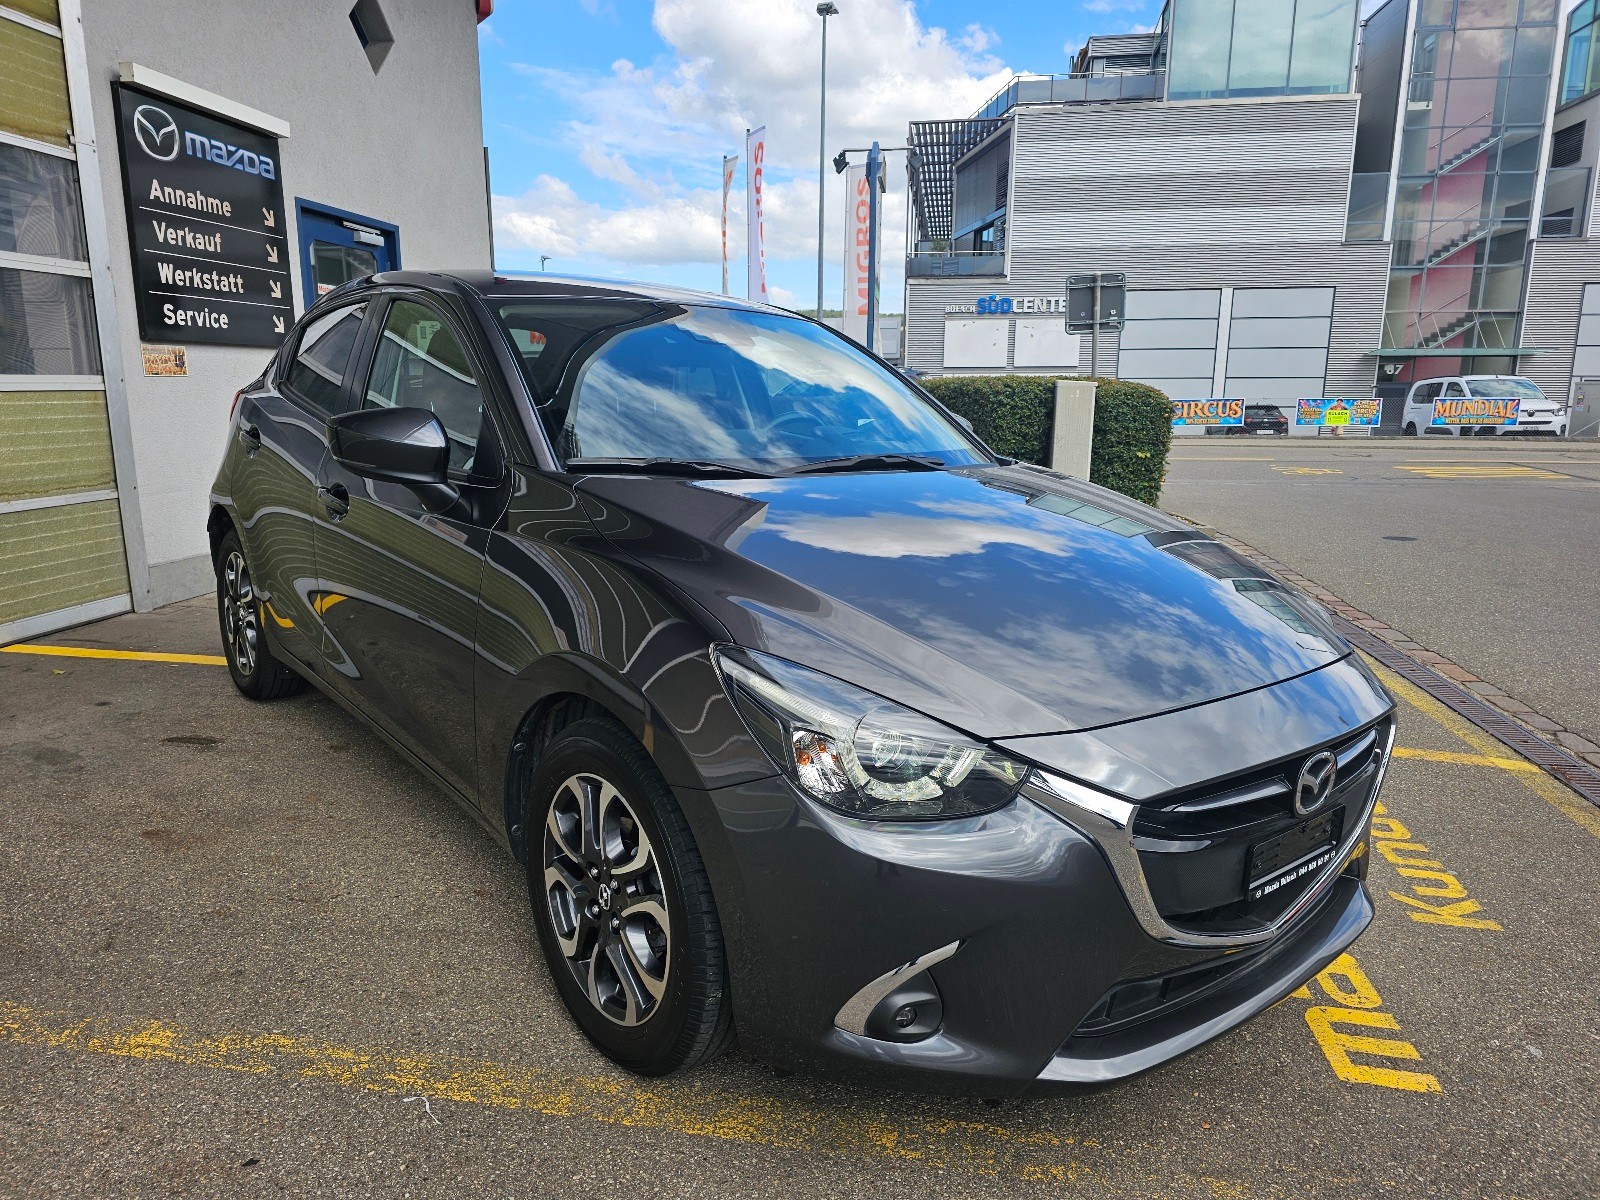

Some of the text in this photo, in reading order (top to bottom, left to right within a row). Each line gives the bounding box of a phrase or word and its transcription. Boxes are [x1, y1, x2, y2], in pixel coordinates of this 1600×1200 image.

[184, 131, 275, 180] mazda
[150, 179, 232, 217] Annahme
[153, 220, 222, 253] Verkauf
[855, 177, 870, 316] MIGROS
[157, 262, 244, 294] Werkstatt
[163, 303, 229, 329] Service
[977, 294, 1066, 314] SÜDCENTE
[1434, 400, 1519, 419] MUNDIAL
